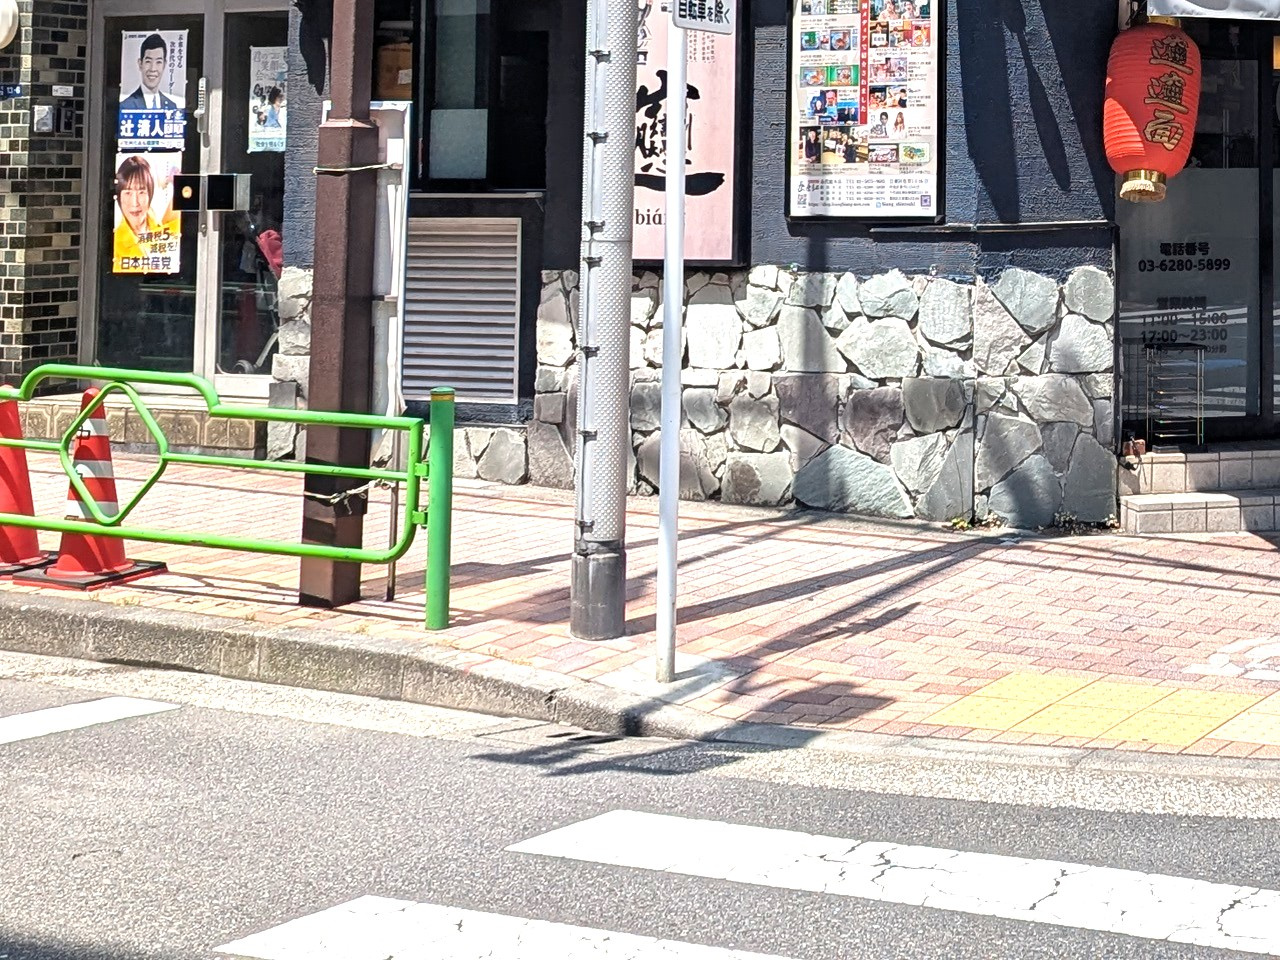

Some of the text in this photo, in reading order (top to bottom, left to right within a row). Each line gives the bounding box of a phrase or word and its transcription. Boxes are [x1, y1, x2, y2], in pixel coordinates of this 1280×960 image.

[1159, 242, 1211, 257] 電話番号
[120, 256, 172, 270] 日本共産党
[1138, 258, 1231, 273] 03-6280-5899
